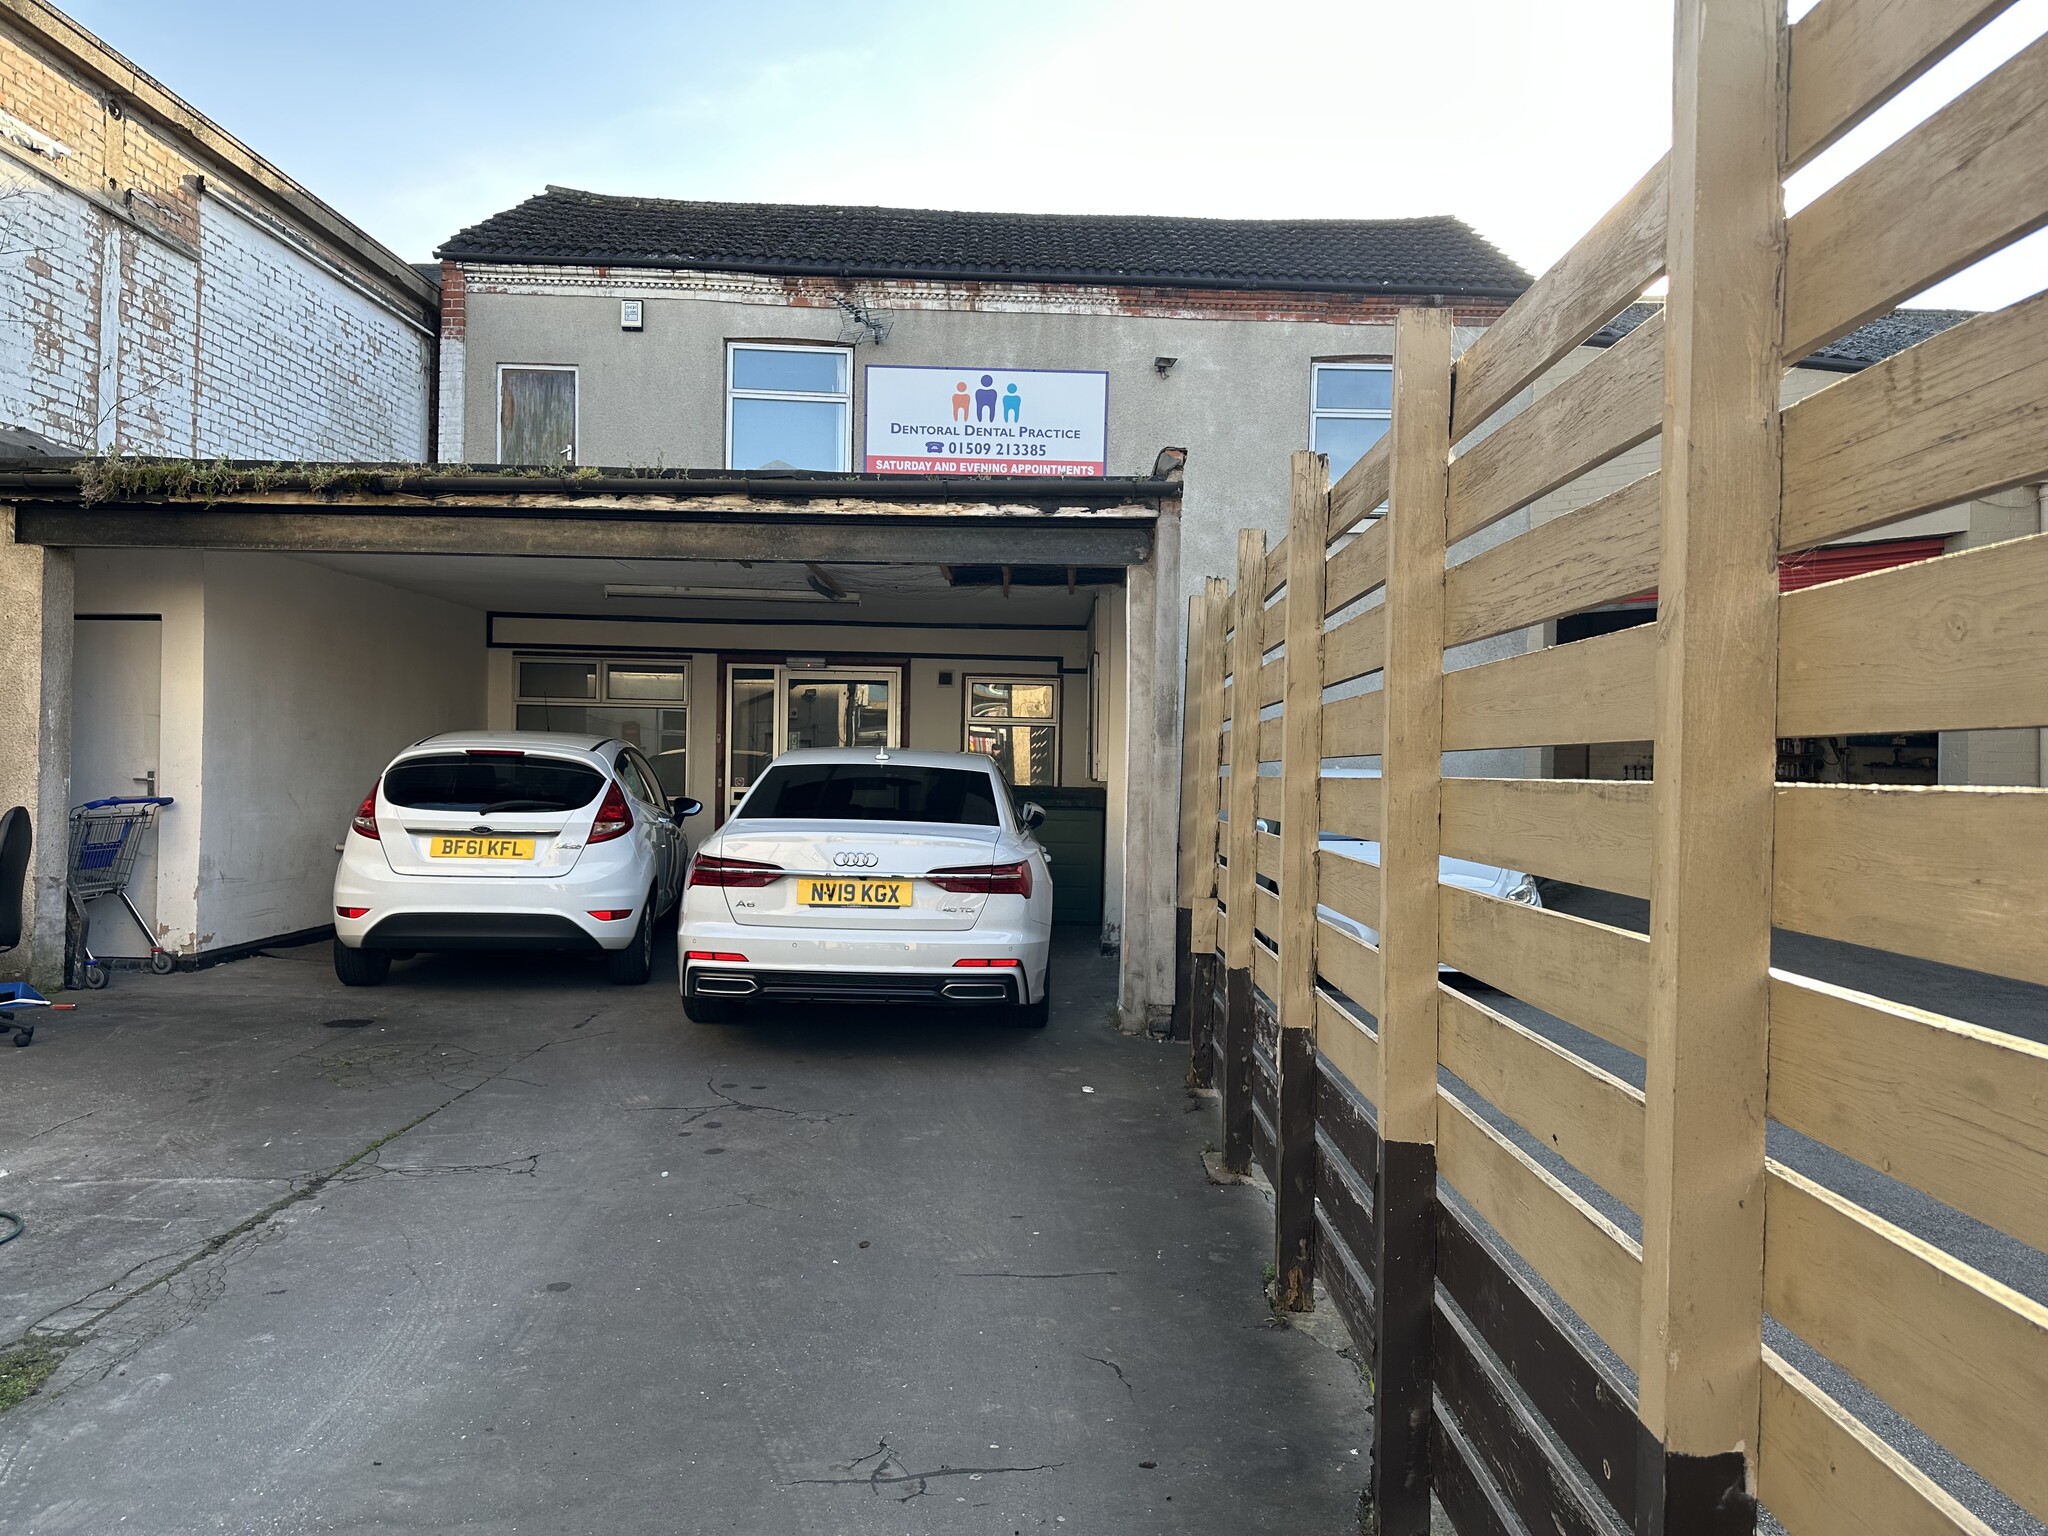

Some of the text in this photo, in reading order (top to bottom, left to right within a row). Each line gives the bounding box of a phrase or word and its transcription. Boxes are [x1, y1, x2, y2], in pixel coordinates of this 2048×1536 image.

[890, 422, 1081, 439] DENTORAL DENTAL PRACTICE
[949, 442, 1046, 456] 01509 213385
[875, 460, 1095, 476] SATURDAY AND EVENING APPOINTMENTS
[441, 839, 523, 856] BF61 KFL
[811, 882, 900, 903] NV19 KGX
[735, 900, 755, 908] A6
